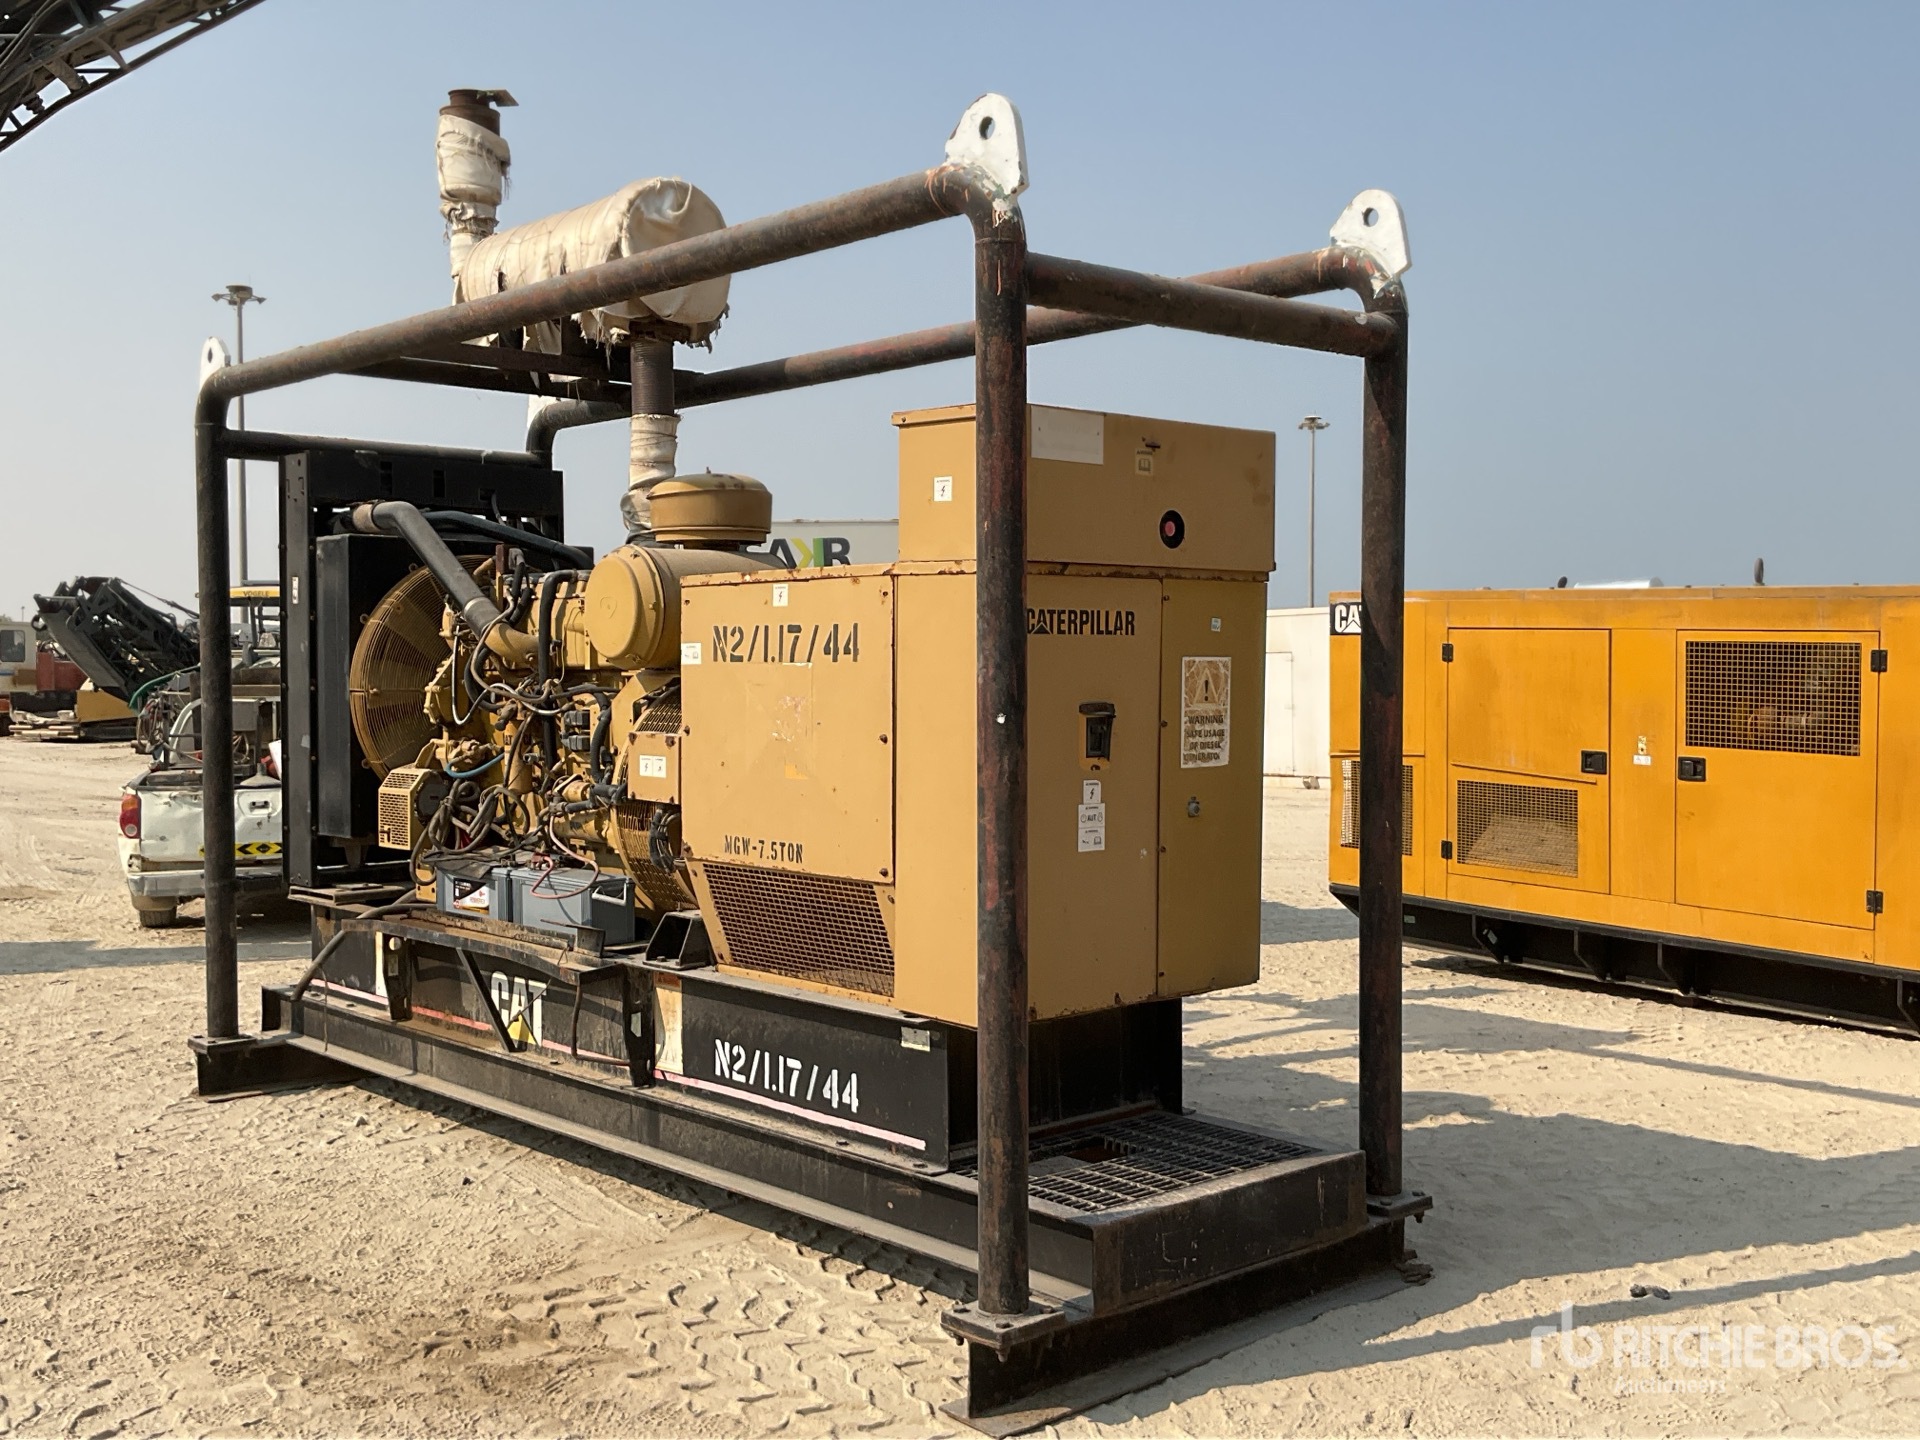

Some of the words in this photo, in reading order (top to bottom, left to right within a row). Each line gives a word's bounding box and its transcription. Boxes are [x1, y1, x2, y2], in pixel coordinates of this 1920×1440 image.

[1026, 608, 1135, 636] CATERPILLAR
[1335, 604, 1362, 633] CA
[1187, 714, 1224, 725] WARNING
[1203, 729, 1225, 738] USAGE
[1199, 741, 1221, 750] DIESEL
[491, 971, 548, 1048] CAT
